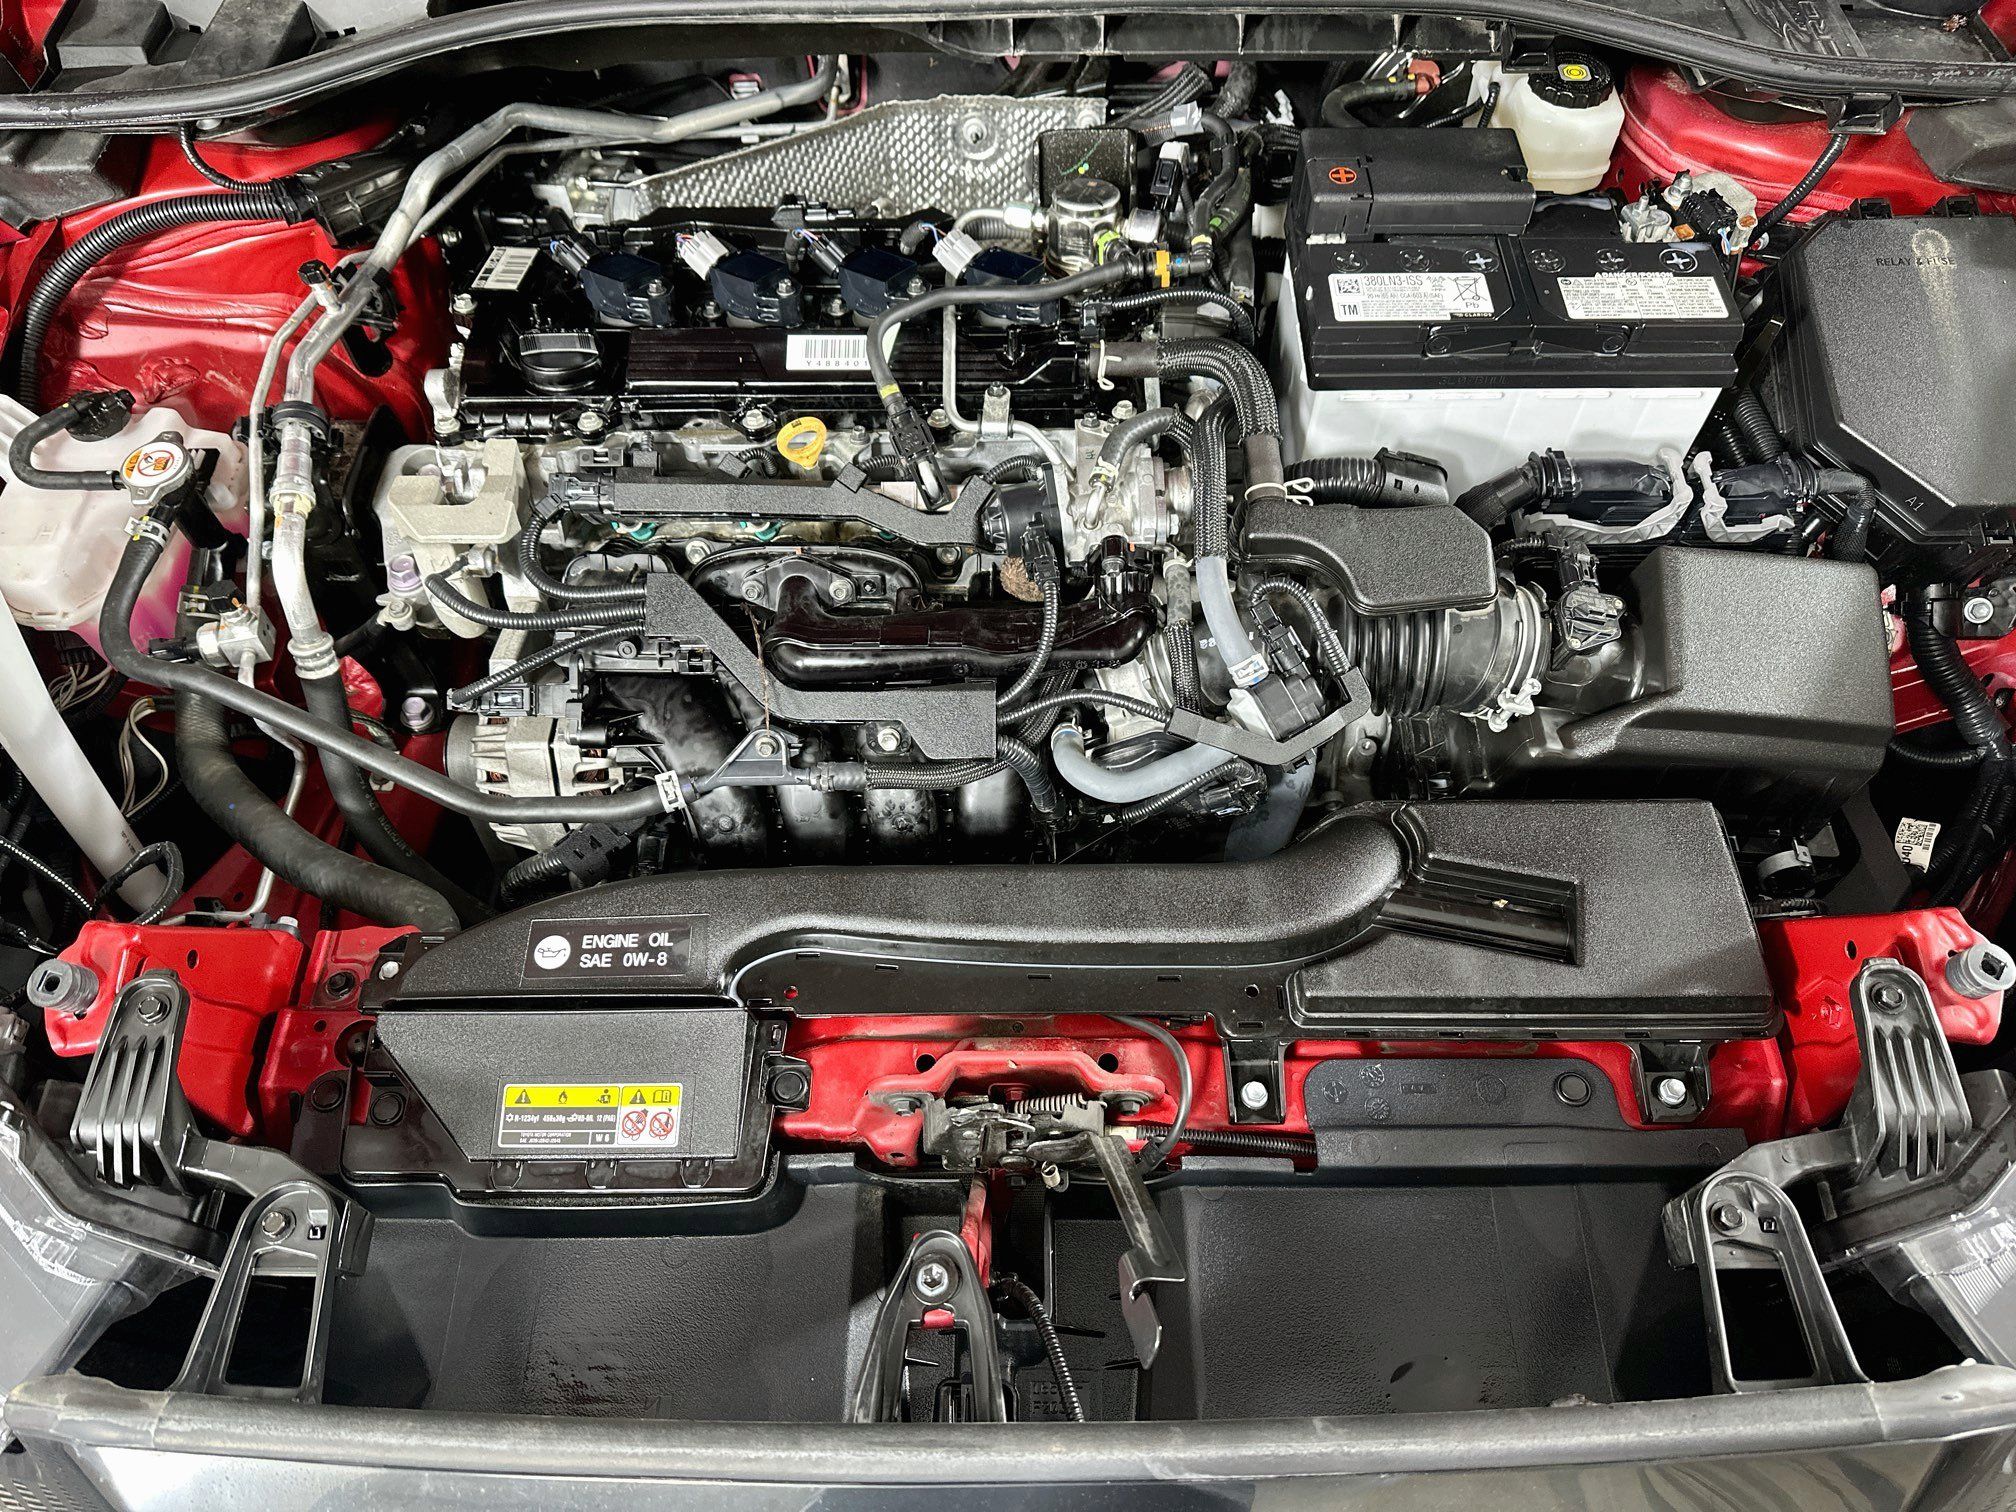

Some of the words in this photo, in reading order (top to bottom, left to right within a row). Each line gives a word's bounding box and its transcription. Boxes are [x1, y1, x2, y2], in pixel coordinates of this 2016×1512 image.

[1876, 257, 1911, 266] RELAY
[1927, 257, 1956, 266] FUSE
[1363, 275, 1423, 287] 380LN3-ISS
[1340, 304, 1359, 316] TM
[1465, 301, 1480, 309] Pb
[1904, 496, 1924, 511] A1
[581, 933, 640, 949] ENGINE
[648, 932, 674, 947] OIL
[579, 953, 613, 968] SAE
[622, 951, 668, 967] 0W-8
[595, 1133, 603, 1143] W
